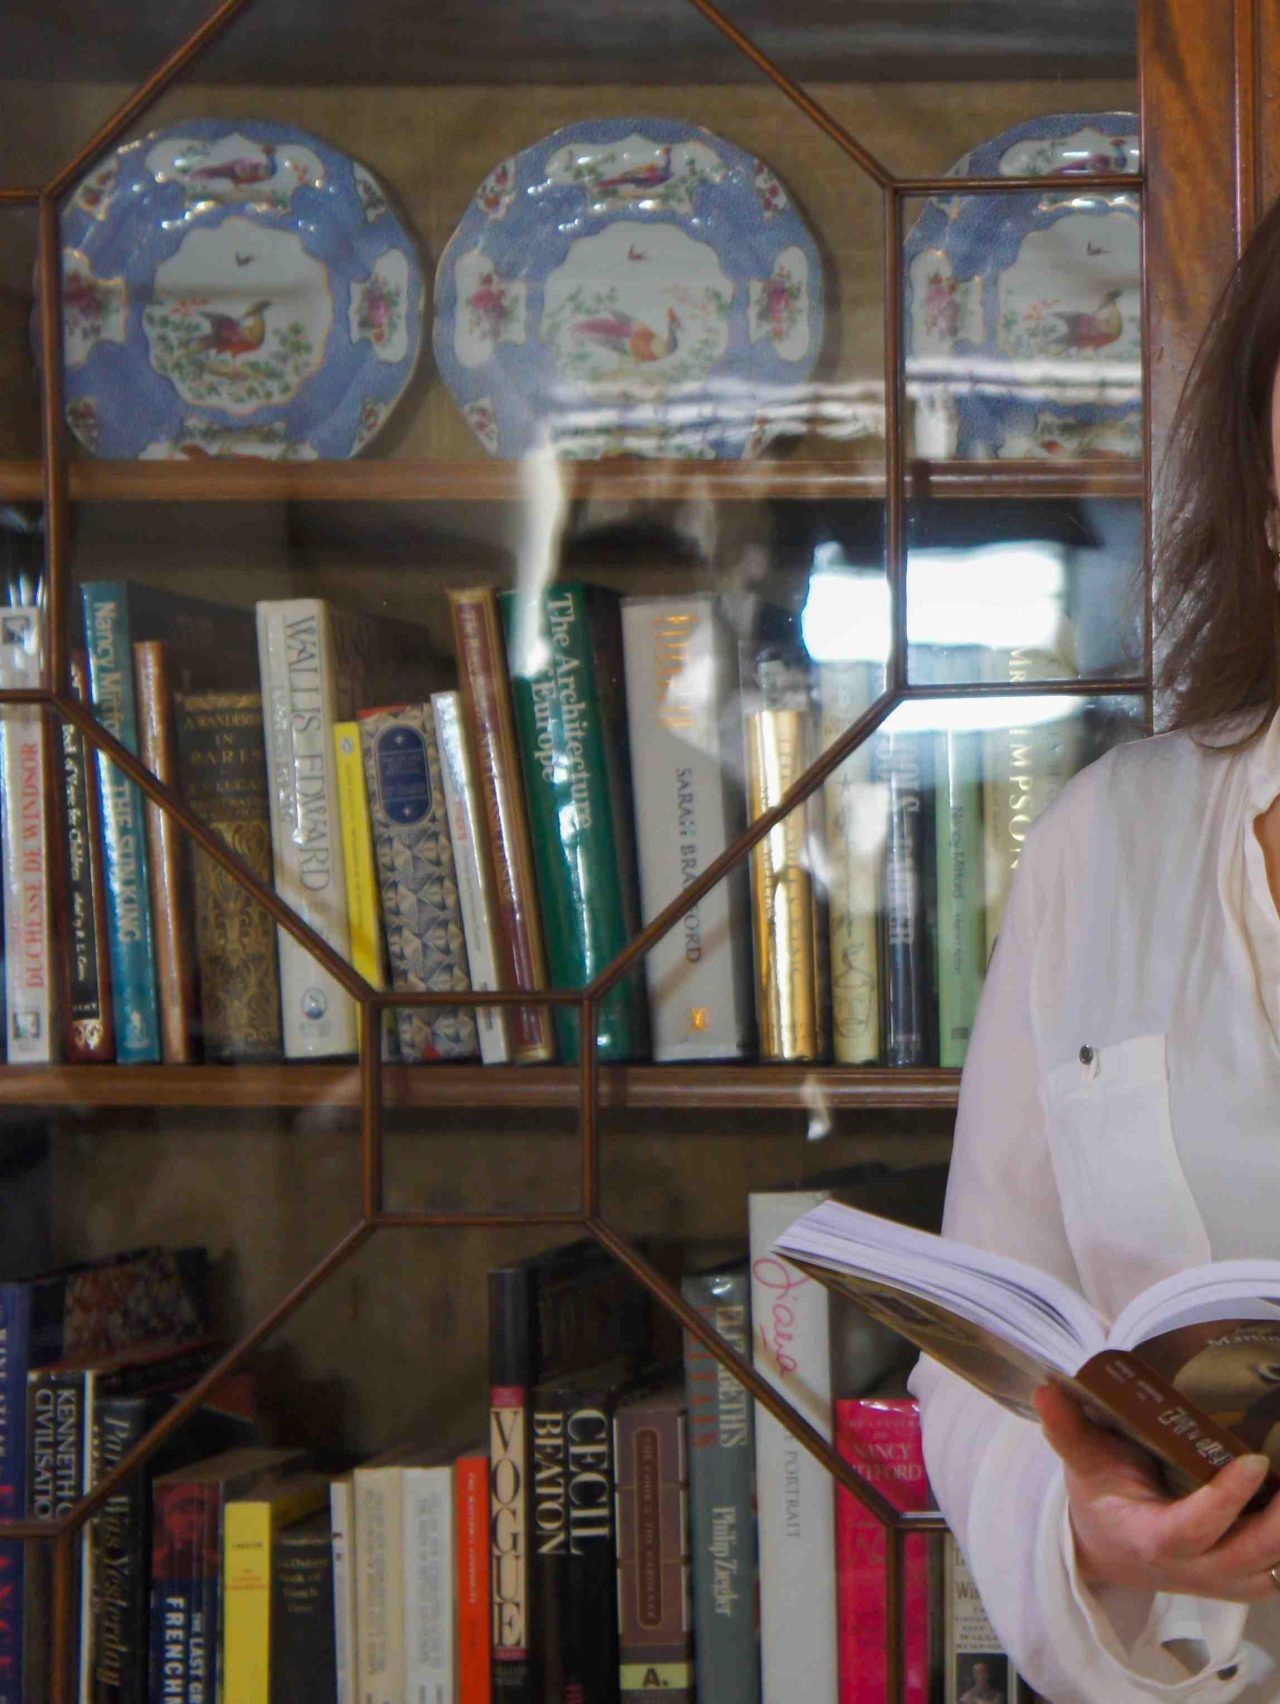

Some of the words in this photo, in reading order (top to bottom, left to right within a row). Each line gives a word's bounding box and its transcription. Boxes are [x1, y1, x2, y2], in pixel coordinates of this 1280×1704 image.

[93, 601, 116, 668] Nancy
[549, 592, 576, 648] The
[1008, 649, 1032, 683] MR
[286, 615, 322, 732] WALLIS
[531, 679, 557, 782] Europe
[557, 656, 592, 829] Architecture
[20, 743, 41, 839] WINDSOR
[299, 753, 331, 892] EDWARD
[676, 767, 695, 837] SARAH
[1008, 729, 1032, 869] IMPSO
[22, 848, 42, 872] DE
[680, 844, 703, 963] BRAORD
[23, 884, 44, 988] DUCHESSE
[34, 1388, 55, 1519] CIVILISATIO
[57, 1389, 77, 1497] KENNETH
[104, 1416, 131, 1474] Par
[533, 1411, 565, 1555] BEATON
[568, 1409, 610, 1556] CECIL
[853, 1443, 911, 1460] NANCY
[491, 1410, 521, 1648] VOGUE
[708, 1505, 737, 1558] Philip
[784, 1451, 802, 1538] PORTRAIT
[97, 1556, 130, 1687] Yesterday
[711, 1559, 739, 1617] Ziegler
[189, 1638, 204, 1678] LAST
[642, 1667, 669, 1687] A.
